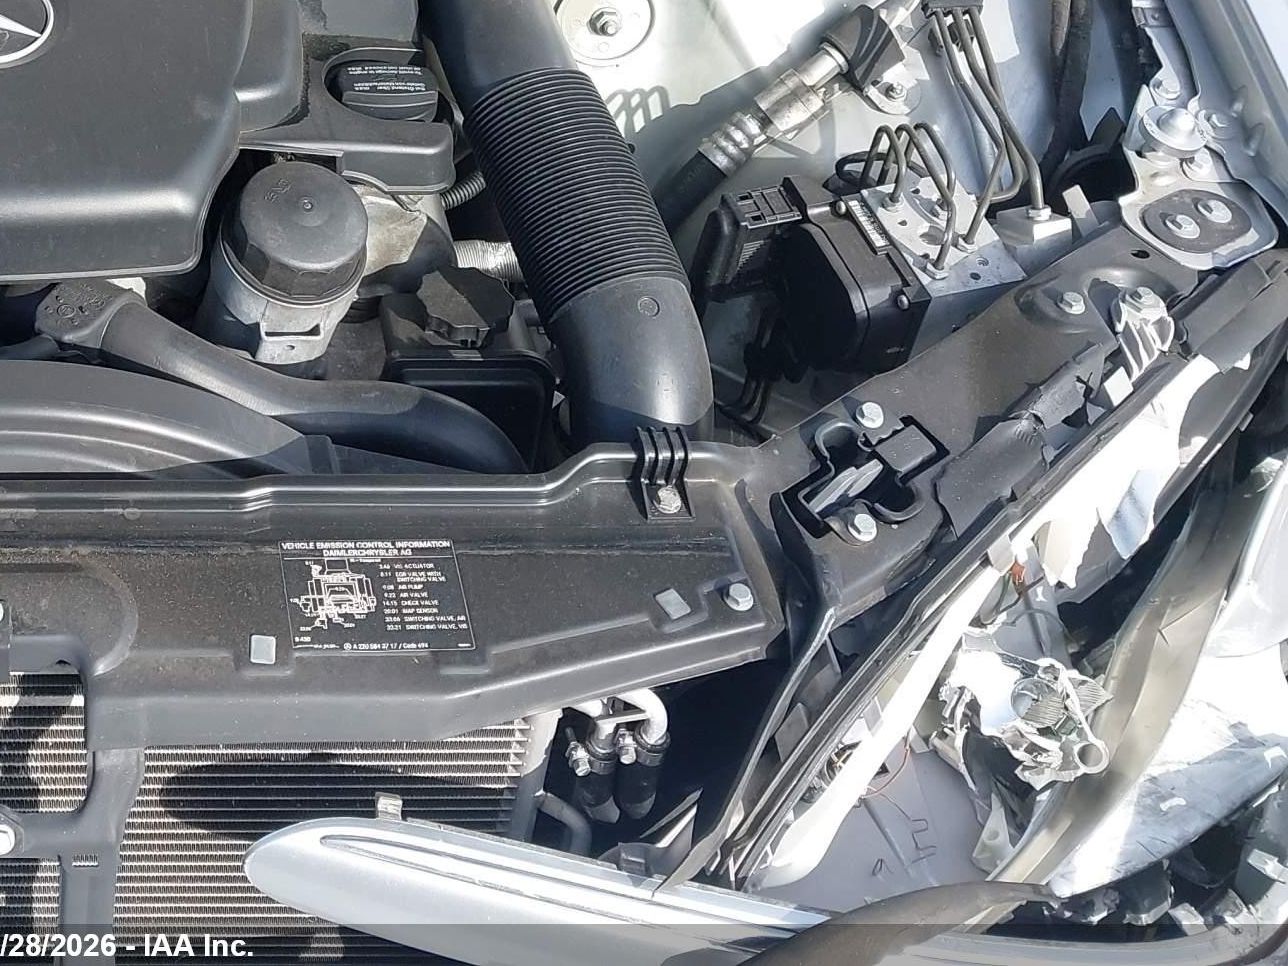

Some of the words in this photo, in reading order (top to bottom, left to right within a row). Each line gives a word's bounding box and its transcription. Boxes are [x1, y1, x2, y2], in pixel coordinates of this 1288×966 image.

[281, 542, 315, 550] VEHICLE
[356, 541, 394, 549] CONTROL
[395, 540, 450, 548] INFORMATION
[323, 549, 399, 557] DAIMLERCHRYSLER
